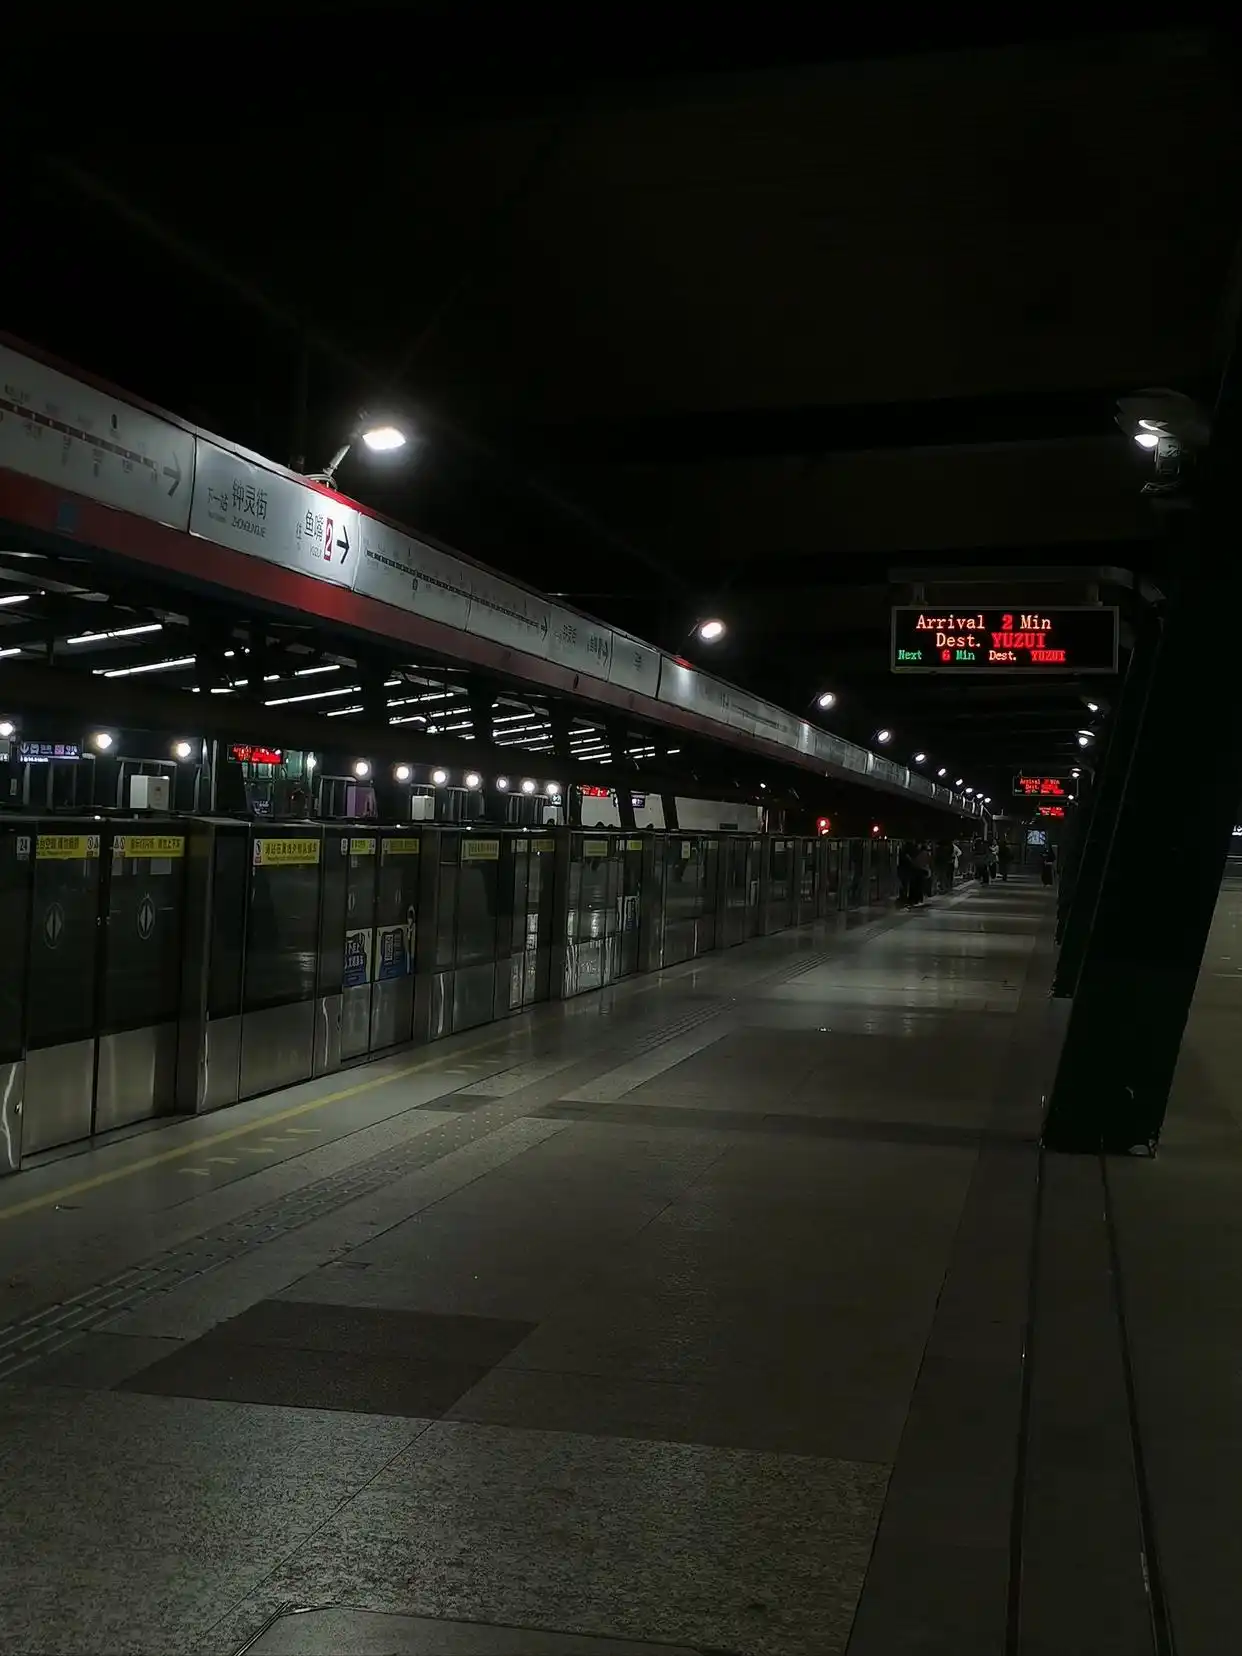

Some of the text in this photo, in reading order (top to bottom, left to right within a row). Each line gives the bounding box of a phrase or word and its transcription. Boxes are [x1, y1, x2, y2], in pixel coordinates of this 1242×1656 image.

[231, 479, 268, 520] 钟灵街
[304, 509, 333, 557] 鱼嘴 2
[916, 614, 1051, 630] Arrival 2 Min
[936, 632, 1046, 648] Dest. YUZUI
[898, 650, 922, 660] Next
[956, 650, 975, 660] Min
[989, 650, 1017, 661] Dest.
